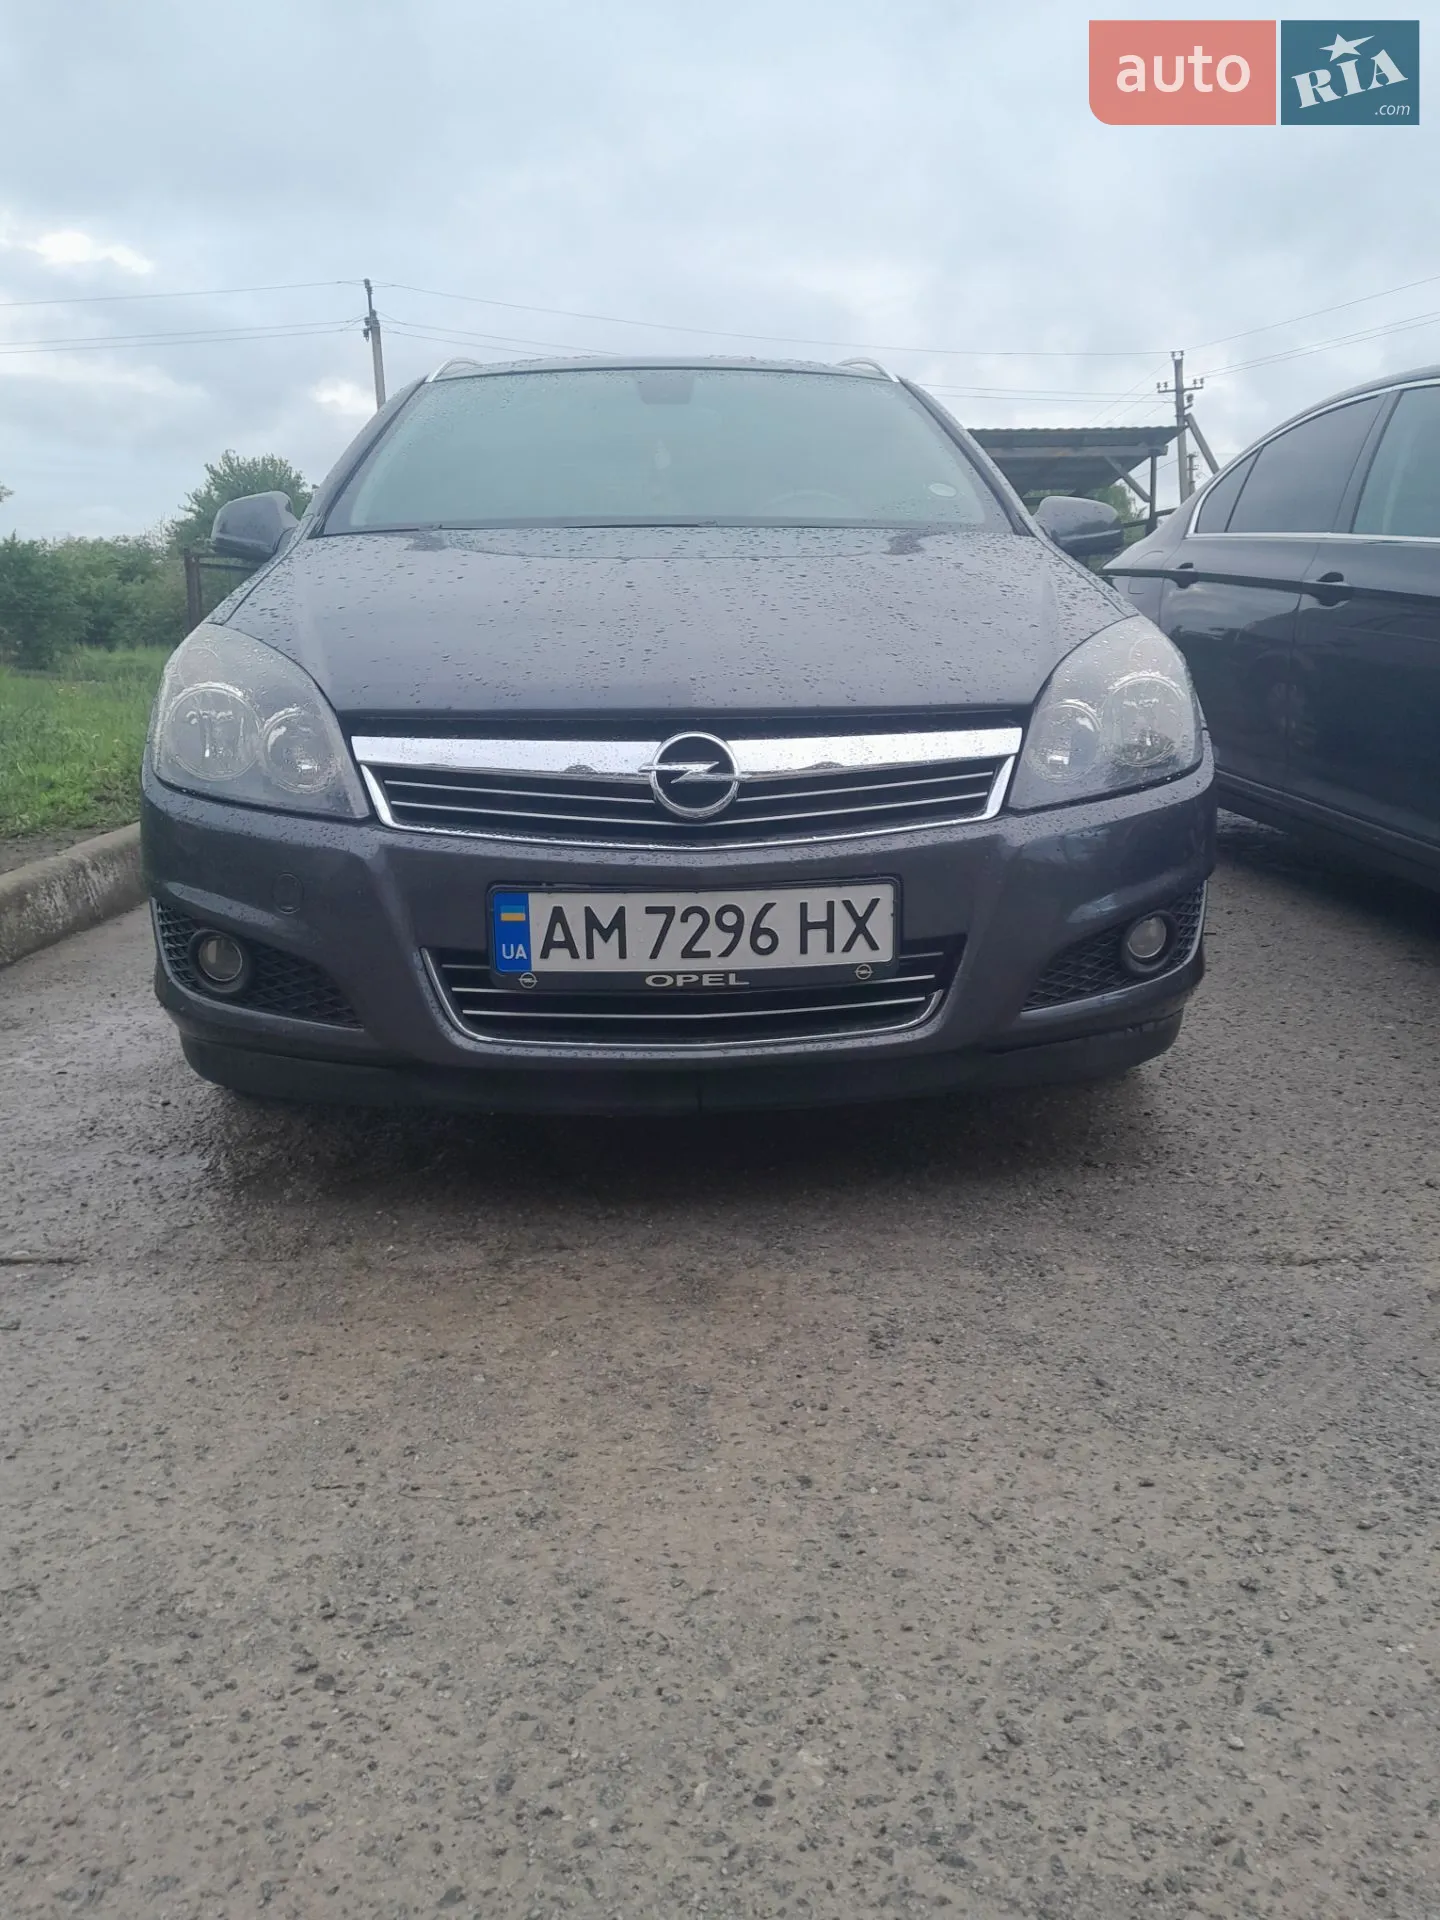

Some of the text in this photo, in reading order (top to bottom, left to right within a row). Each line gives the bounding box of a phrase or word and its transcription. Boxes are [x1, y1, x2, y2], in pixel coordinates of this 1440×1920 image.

[539, 897, 881, 960] AM 7296 HX
[501, 944, 528, 961] UA
[645, 973, 751, 988] OPEL
